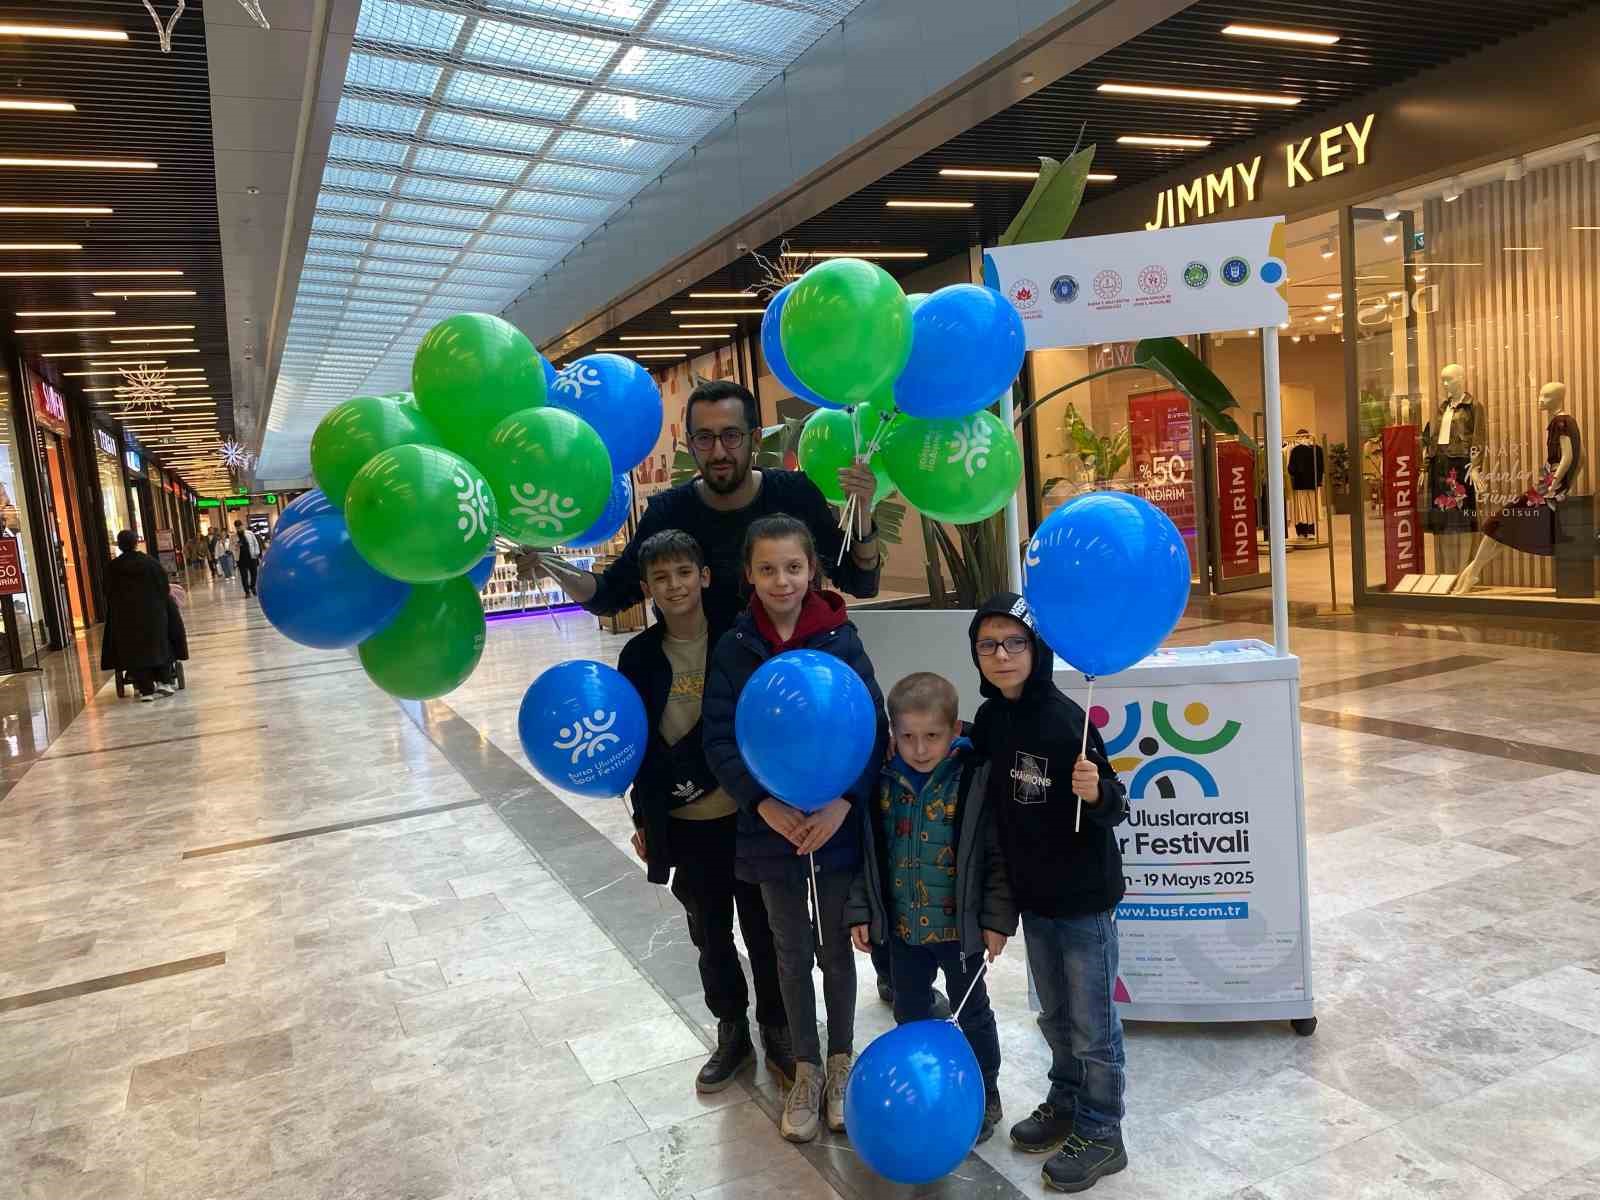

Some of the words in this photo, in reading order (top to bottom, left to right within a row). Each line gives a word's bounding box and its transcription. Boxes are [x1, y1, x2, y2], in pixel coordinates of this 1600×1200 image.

[1145, 155, 1262, 231] JIMMY
[1286, 113, 1375, 188] KEY
[1230, 466, 1249, 565] İNDİRİM
[1393, 455, 1413, 570] İNDİRİM
[1128, 808, 1249, 827] Uluslararası
[1134, 829, 1249, 855] Festivali
[1144, 873, 1159, 887] 19
[1162, 873, 1211, 889] Mayıs
[1214, 871, 1254, 885] 2025
[1118, 905, 1241, 917] ww.busf.com.tr
